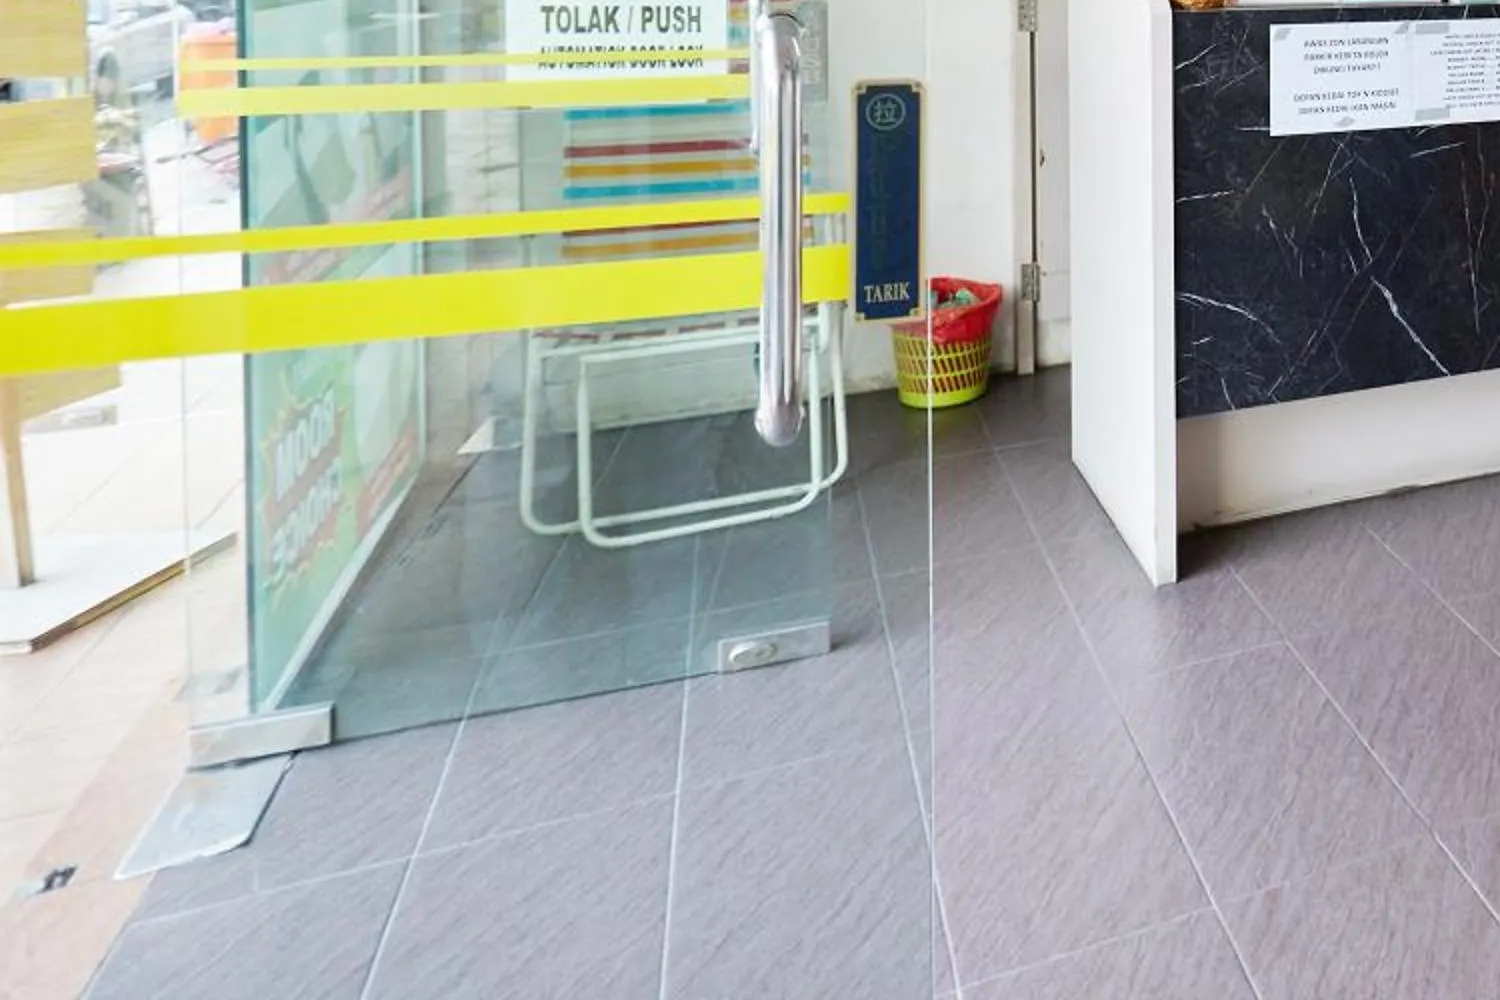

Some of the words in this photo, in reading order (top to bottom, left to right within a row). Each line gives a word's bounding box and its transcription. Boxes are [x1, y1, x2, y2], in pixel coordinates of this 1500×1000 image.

[541, 4, 620, 34] TOLAK
[641, 5, 702, 33] PUSH
[873, 101, 898, 124] 拉
[864, 281, 910, 304] TARIK
